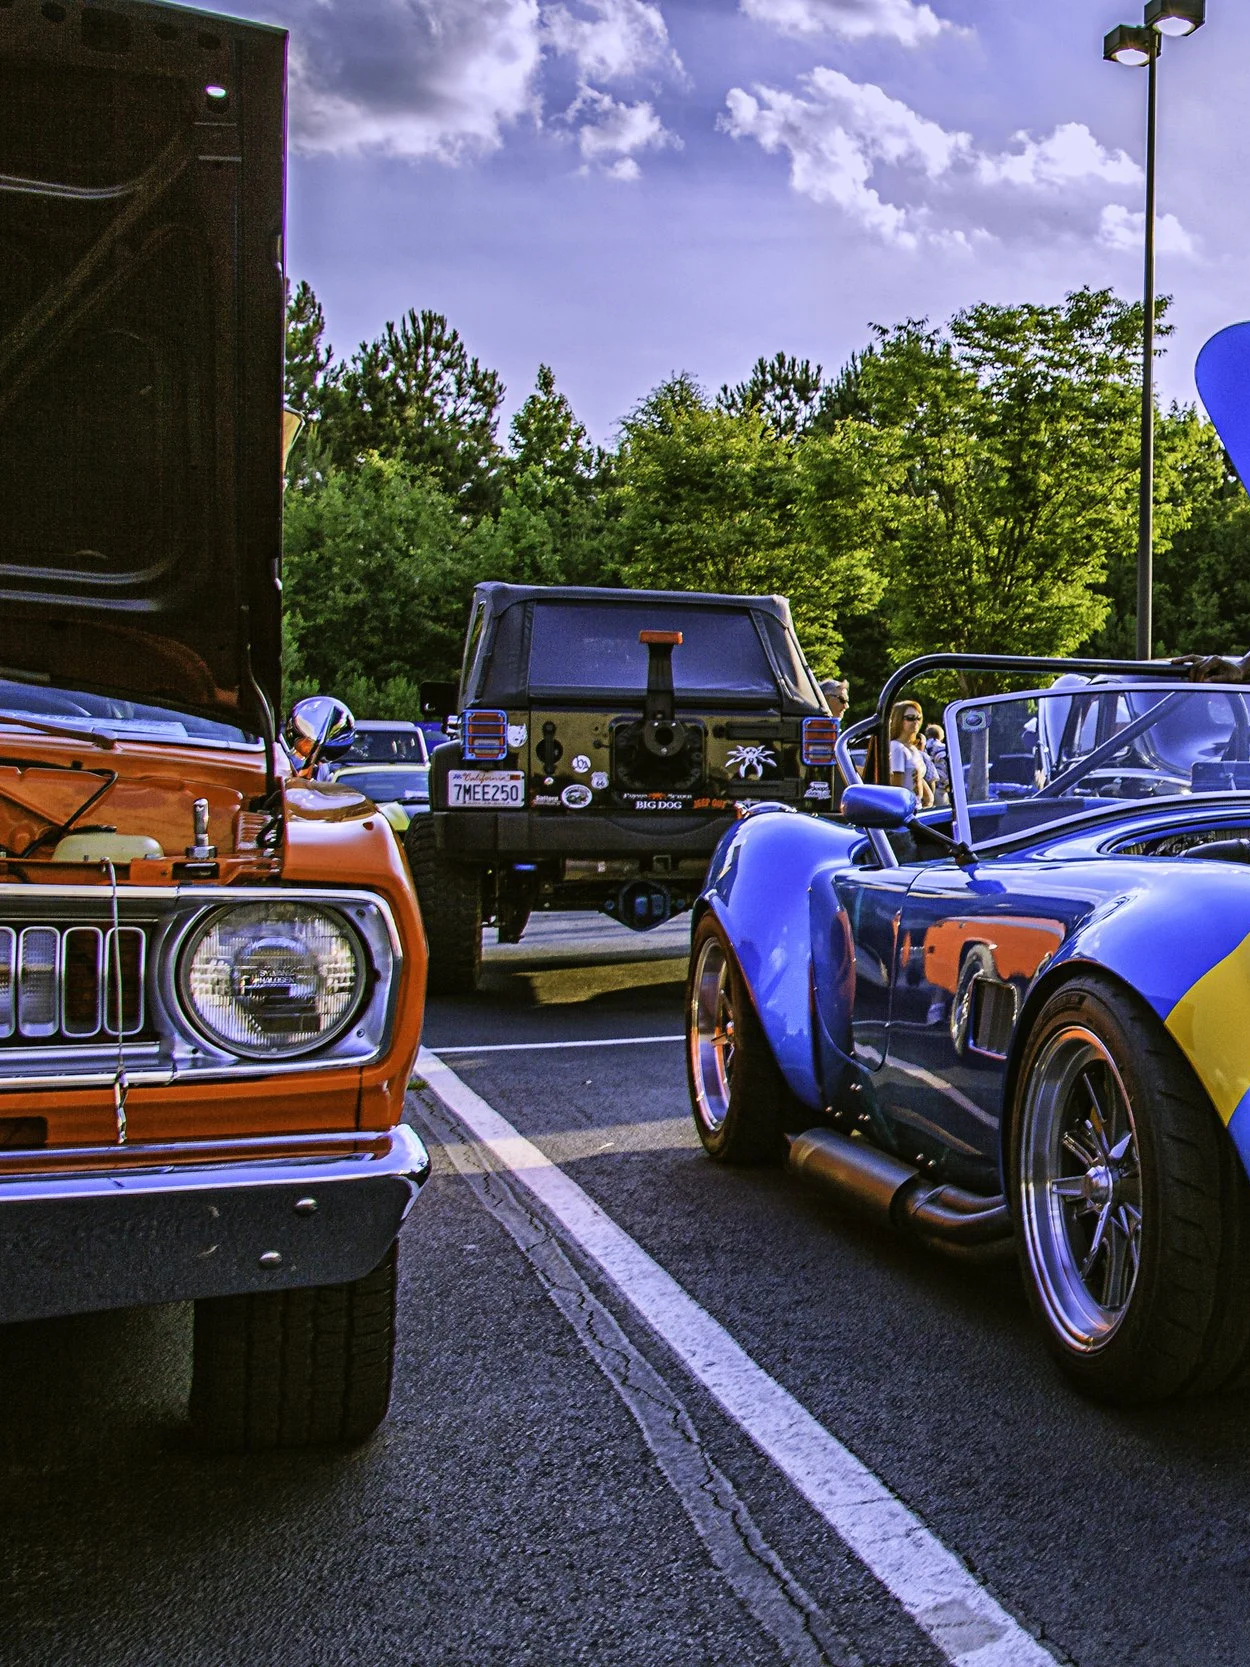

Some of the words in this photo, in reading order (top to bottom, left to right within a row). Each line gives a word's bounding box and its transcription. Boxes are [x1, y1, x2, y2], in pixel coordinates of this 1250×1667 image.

[453, 784, 519, 801] 7MEE250
[635, 800, 657, 809] BIG
[657, 800, 683, 809] DOG
